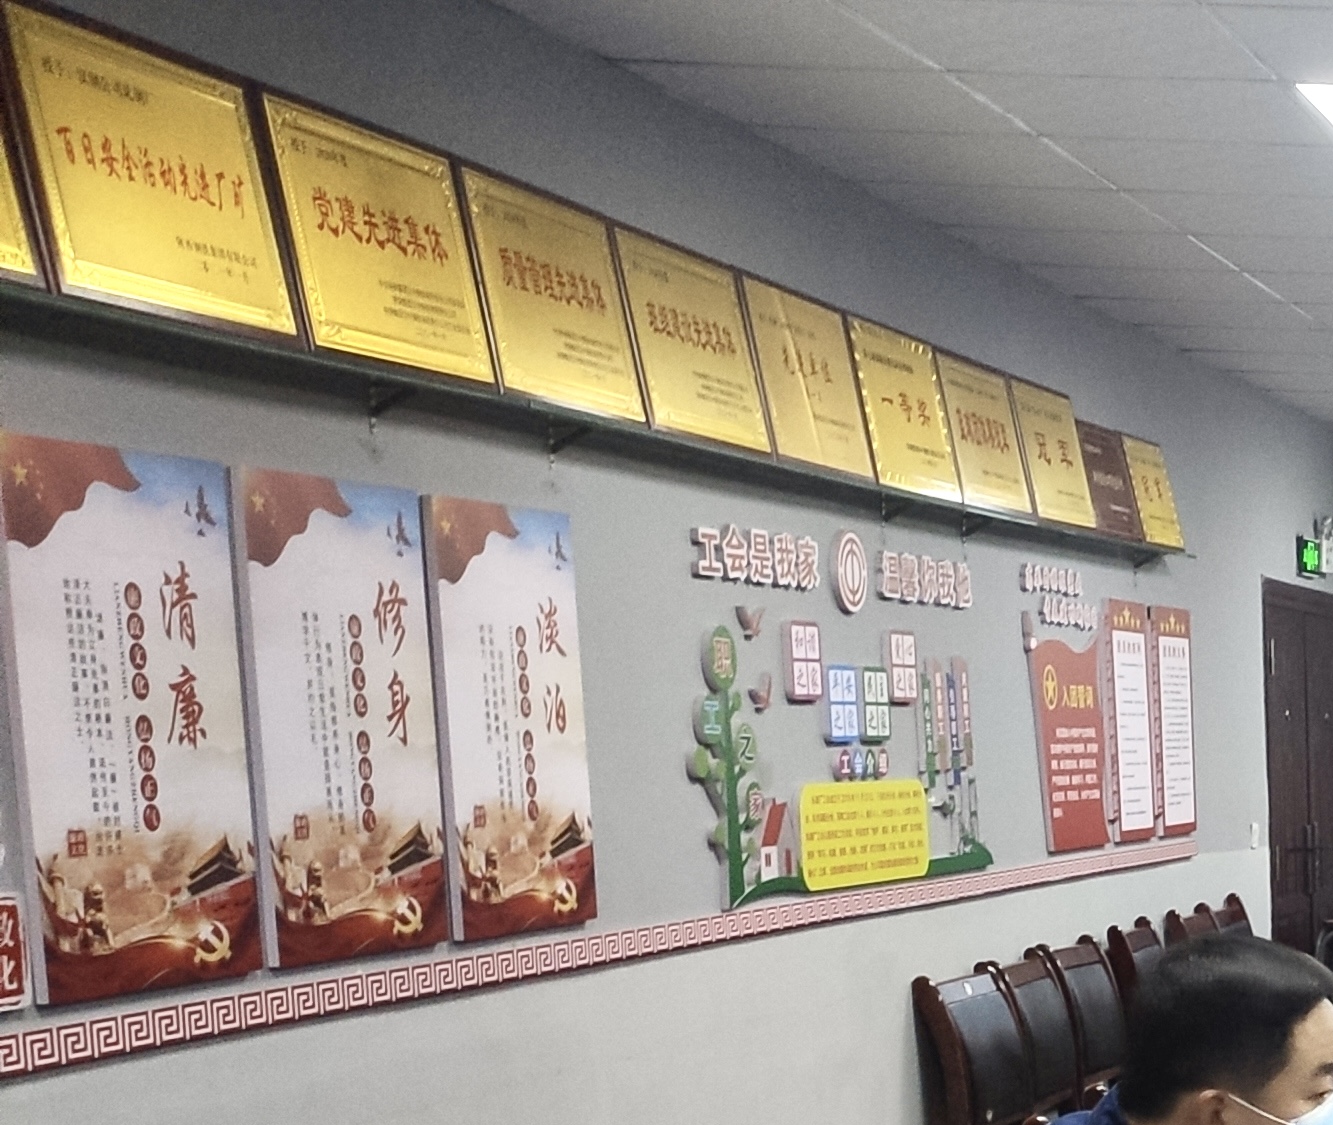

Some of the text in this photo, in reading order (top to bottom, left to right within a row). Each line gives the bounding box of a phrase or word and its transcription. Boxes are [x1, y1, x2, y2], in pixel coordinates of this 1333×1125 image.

[312, 186, 449, 268] 党建先进集体
[697, 524, 820, 590] 工会是我家
[158, 560, 209, 750] 清廉
[373, 580, 411, 747] 修身
[535, 596, 567, 734] 淡泊
